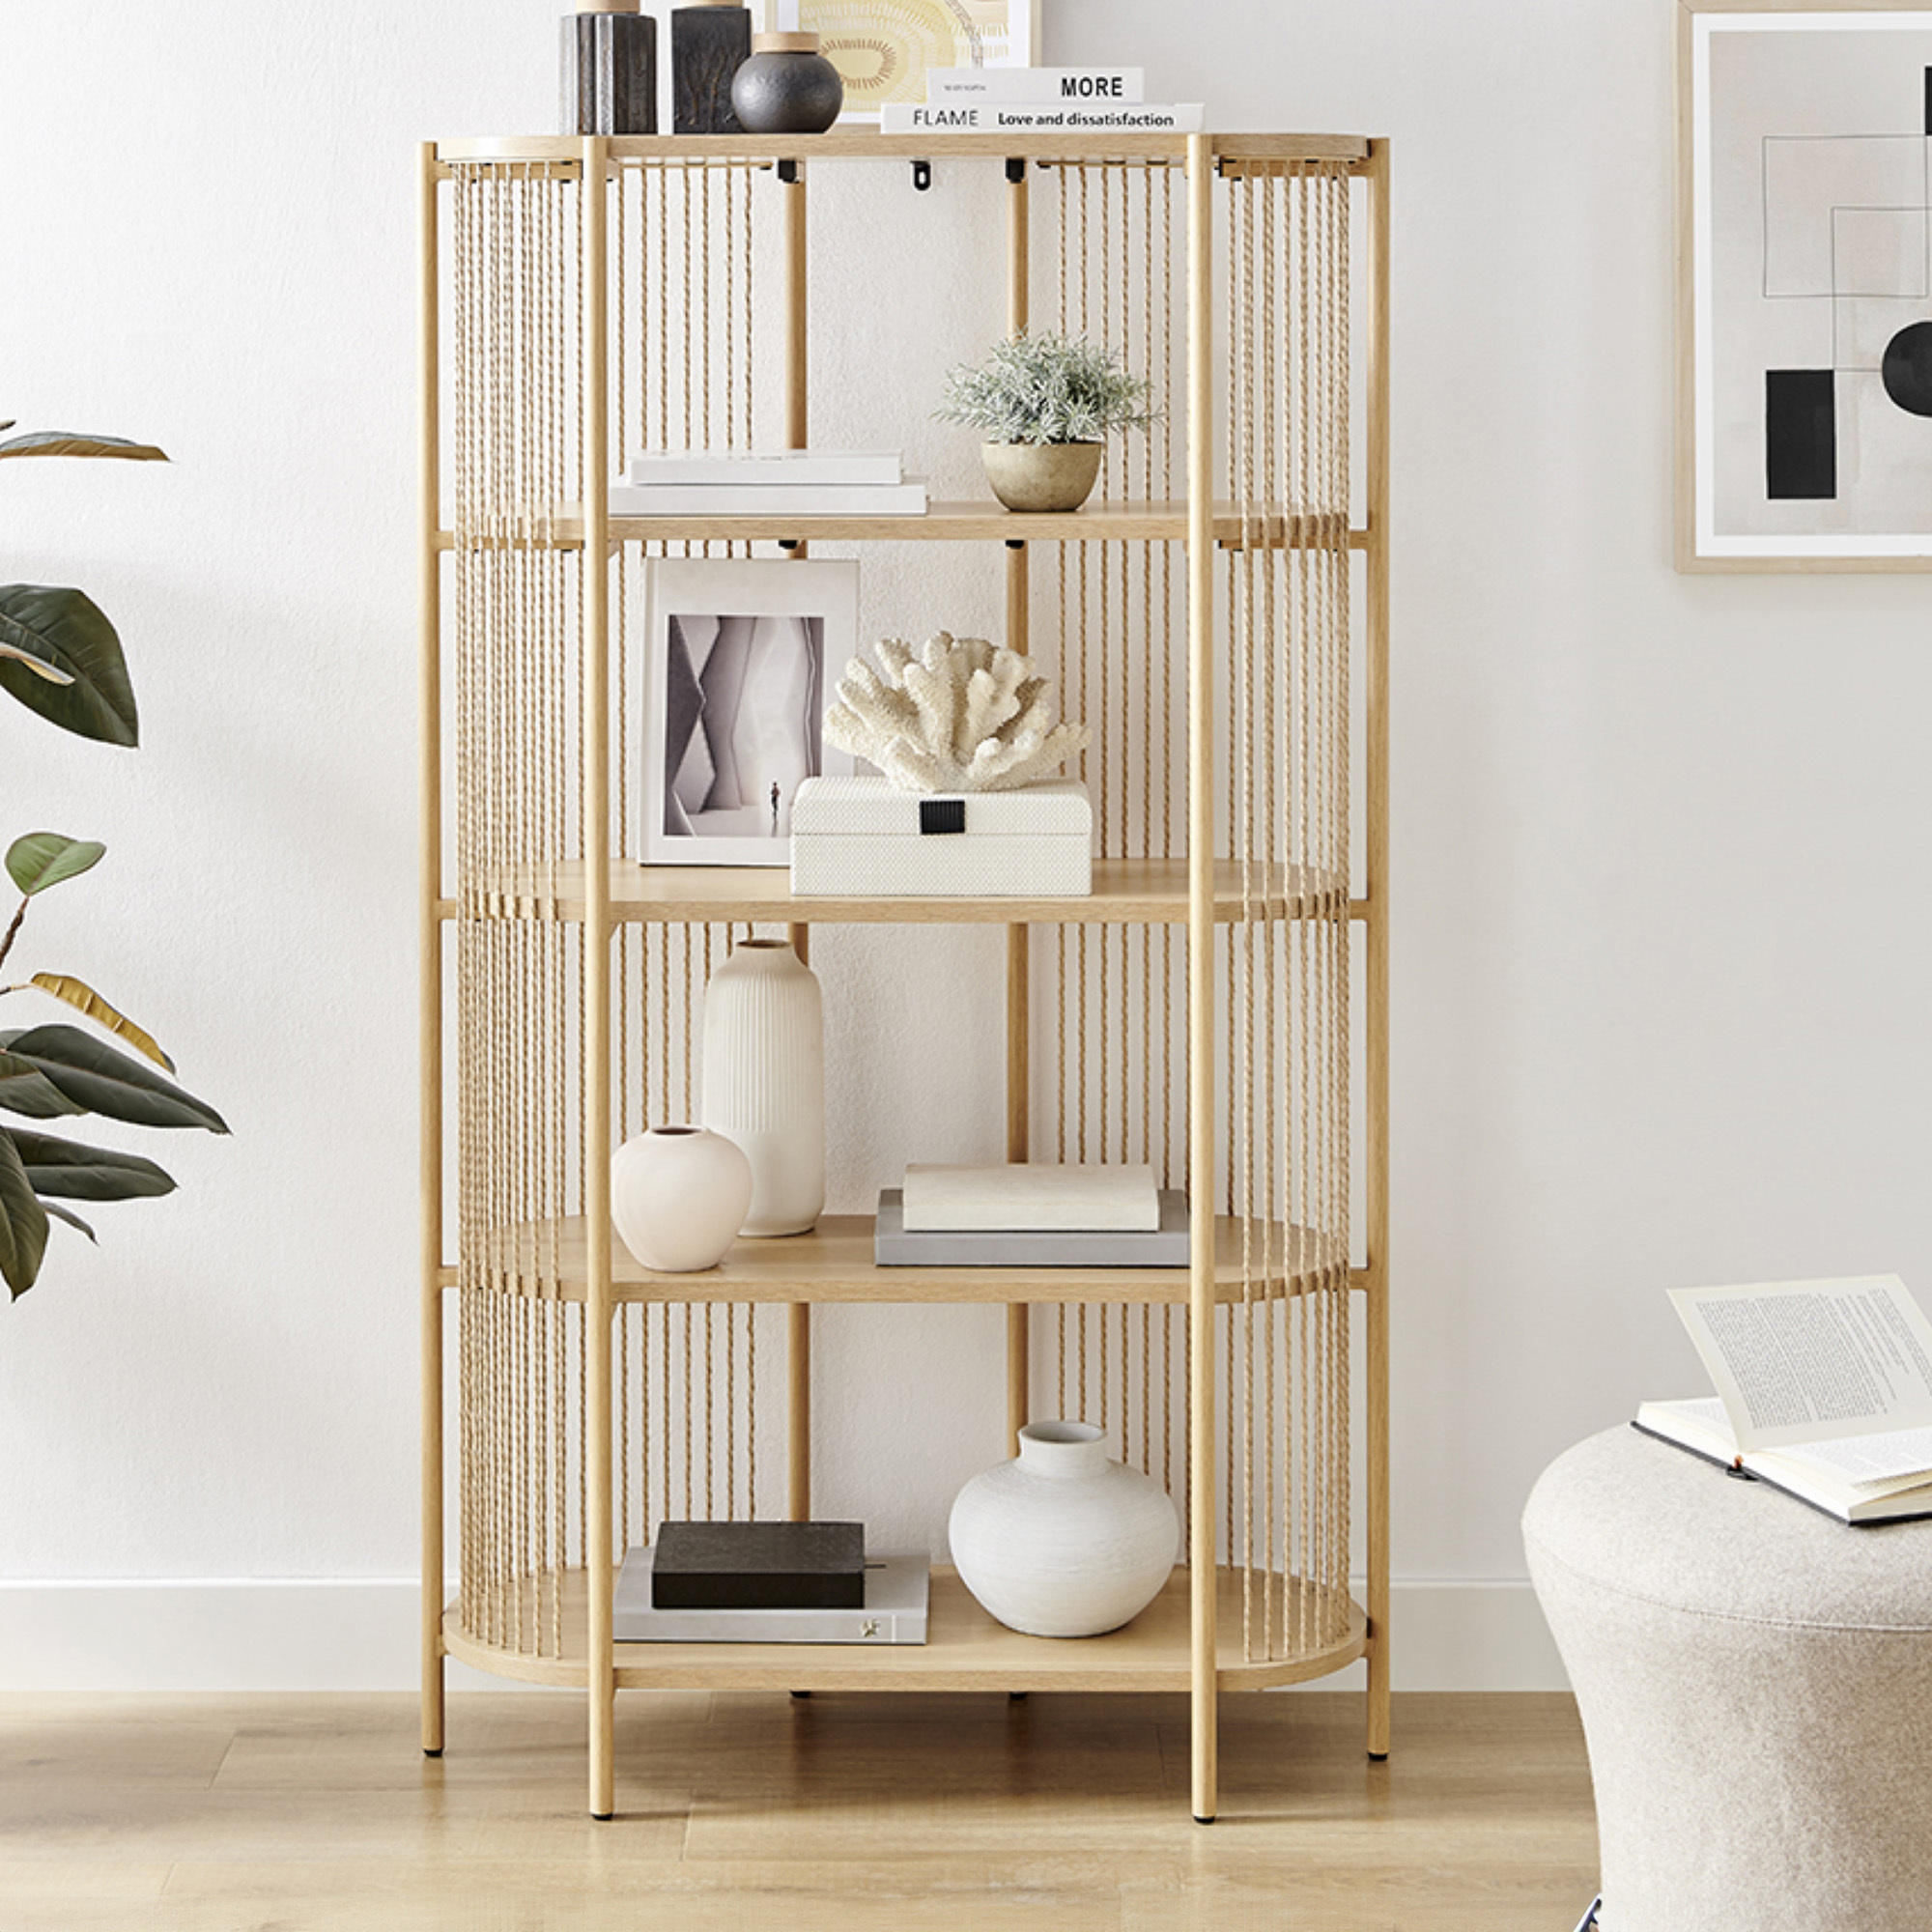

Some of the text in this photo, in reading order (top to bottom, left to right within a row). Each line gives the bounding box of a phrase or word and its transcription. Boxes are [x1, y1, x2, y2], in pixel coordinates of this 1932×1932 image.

[1061, 76, 1123, 97] MORE
[913, 109, 979, 126] FLAME
[998, 112, 1175, 127] Love and dissatisfaction
